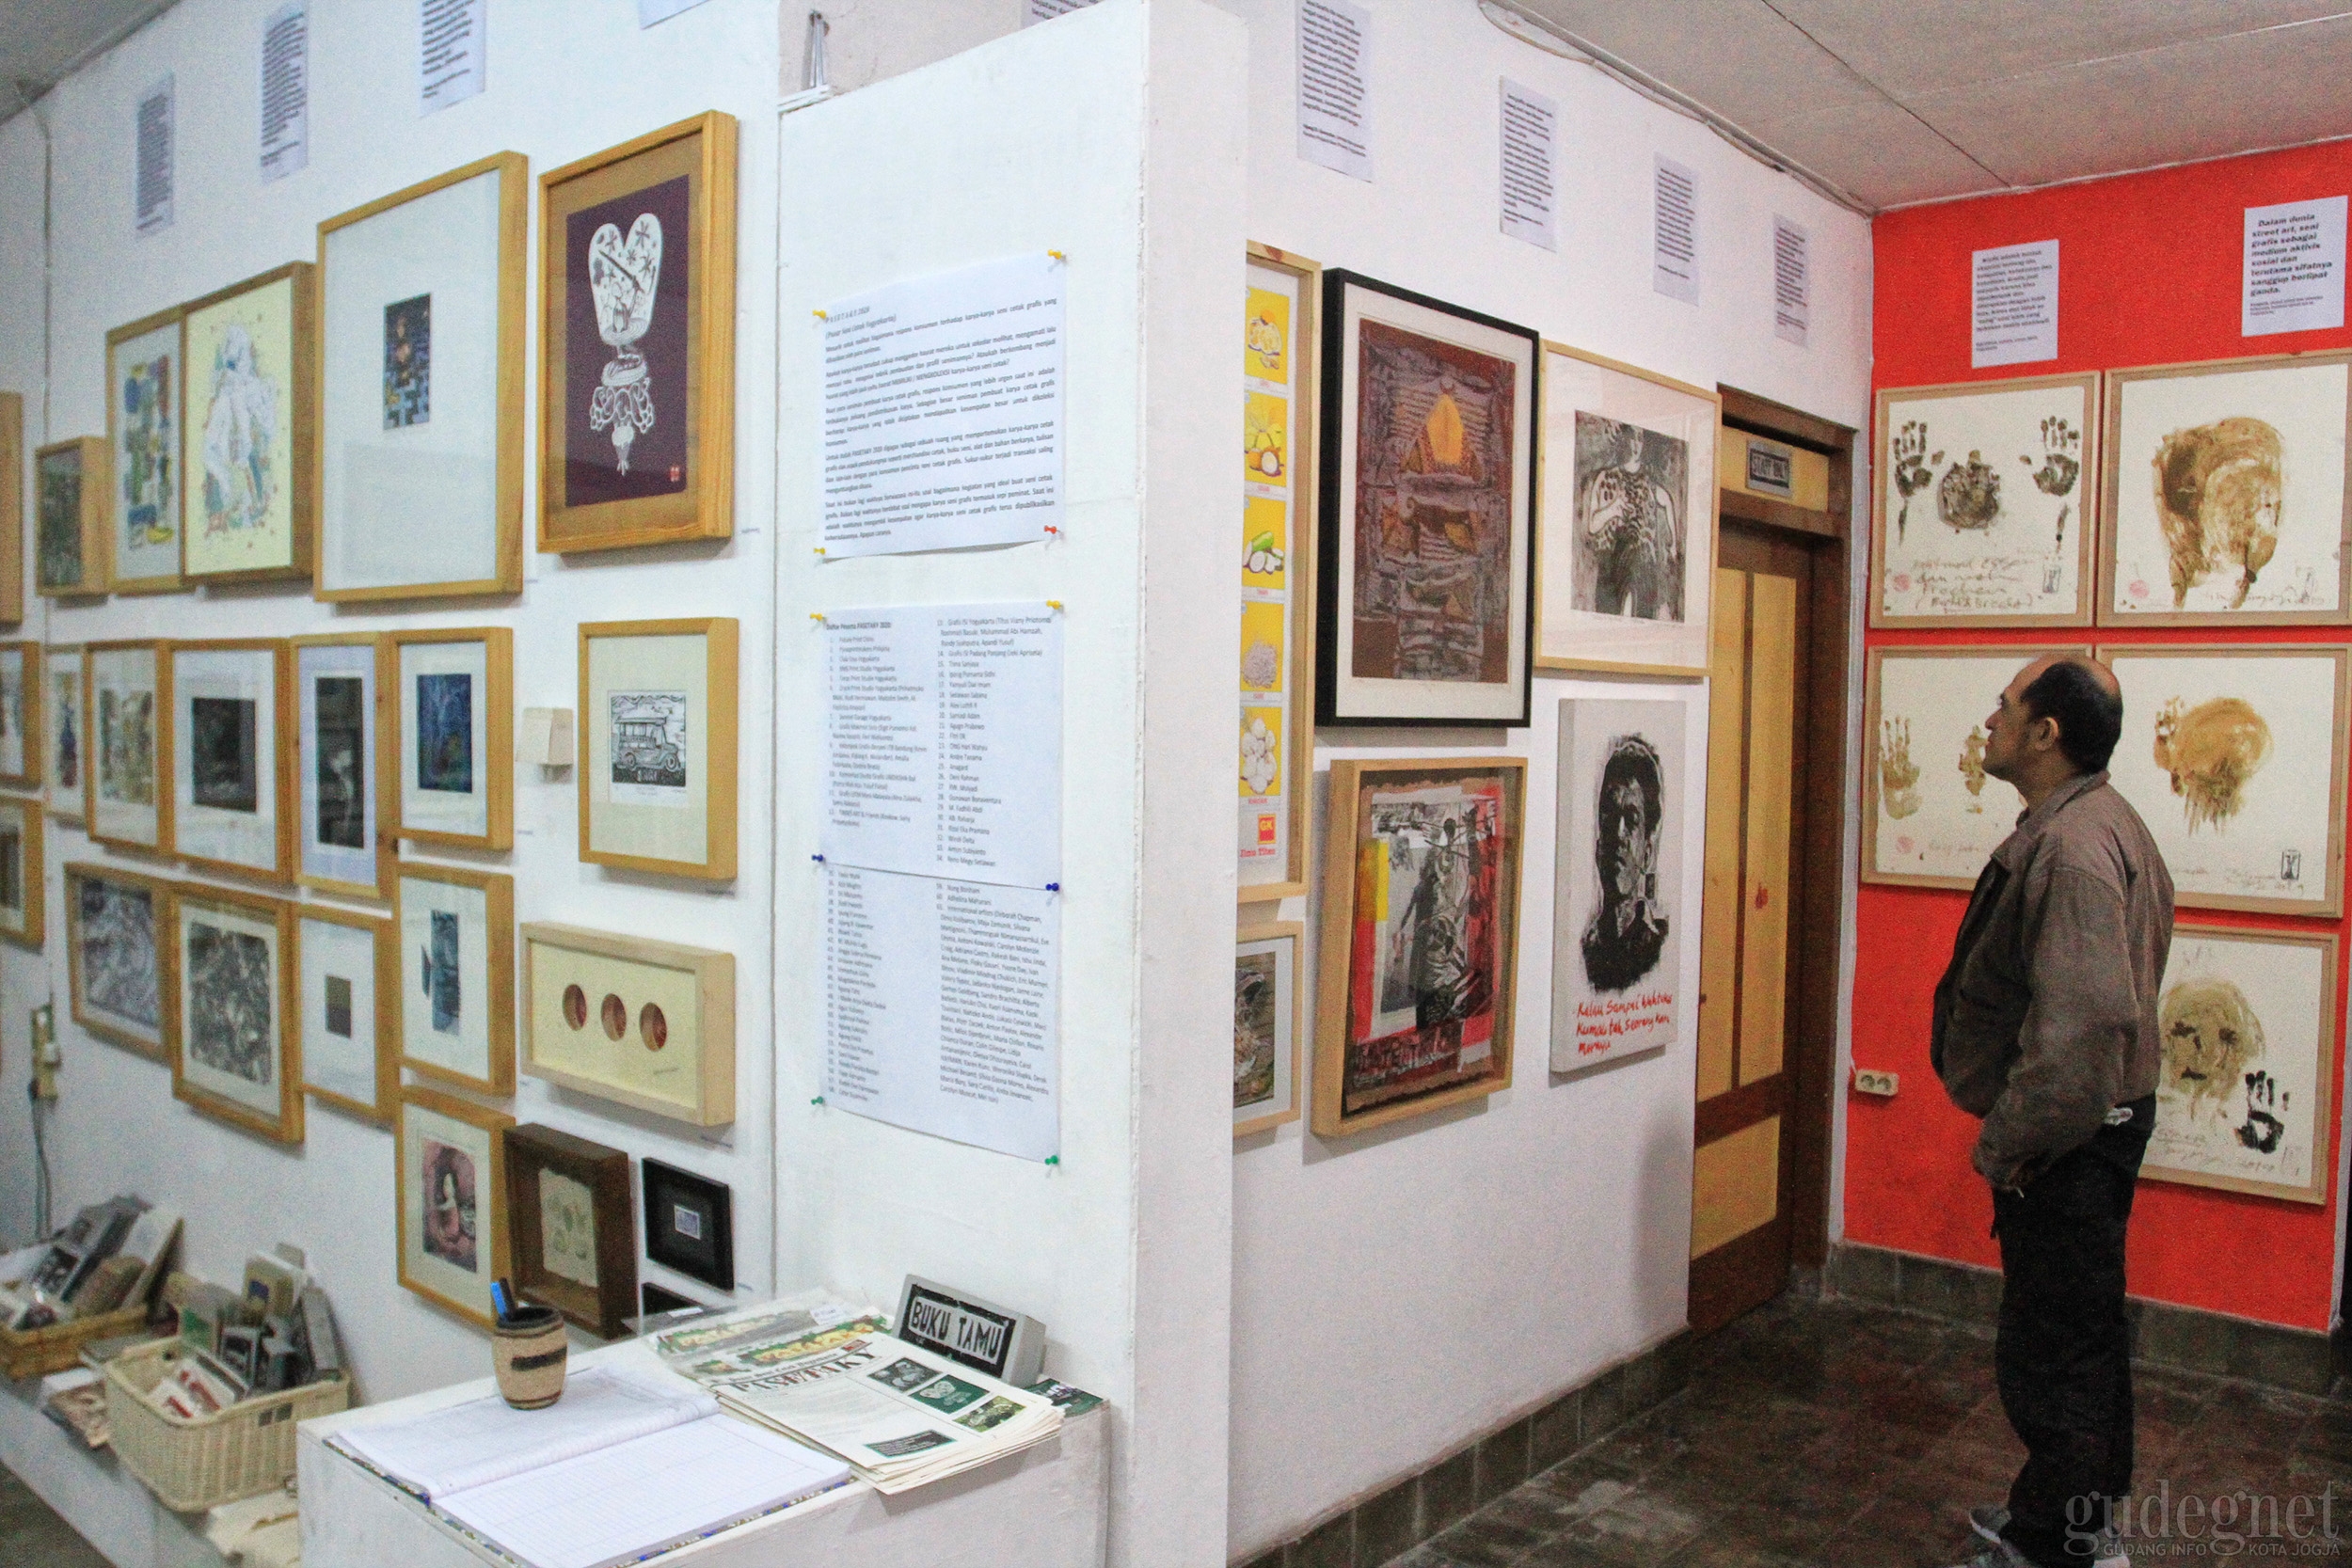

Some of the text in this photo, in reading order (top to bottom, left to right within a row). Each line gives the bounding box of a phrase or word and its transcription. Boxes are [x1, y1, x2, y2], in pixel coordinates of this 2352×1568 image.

[2258, 214, 2315, 227] Dalam dunia
[2252, 228, 2280, 238] street
[2299, 222, 2320, 232] seni
[2251, 231, 2318, 248] grafis sebagai
[2251, 243, 2321, 257] medium aktivis
[2251, 255, 2298, 266] sosial dan
[2251, 266, 2294, 277] terutama
[2251, 276, 2289, 286] sanggup
[1009, 303, 1025, 313] cetak
[1026, 298, 1042, 310] grafis
[1044, 297, 1057, 308] yang
[1000, 342, 1033, 355] berkembang
[1041, 378, 1056, 388] grafis
[1009, 422, 1040, 434] karya-karya
[1040, 420, 1054, 430] cetak
[1038, 473, 1053, 483] cetak
[912, 1300, 1003, 1357] BUKU TAMU
